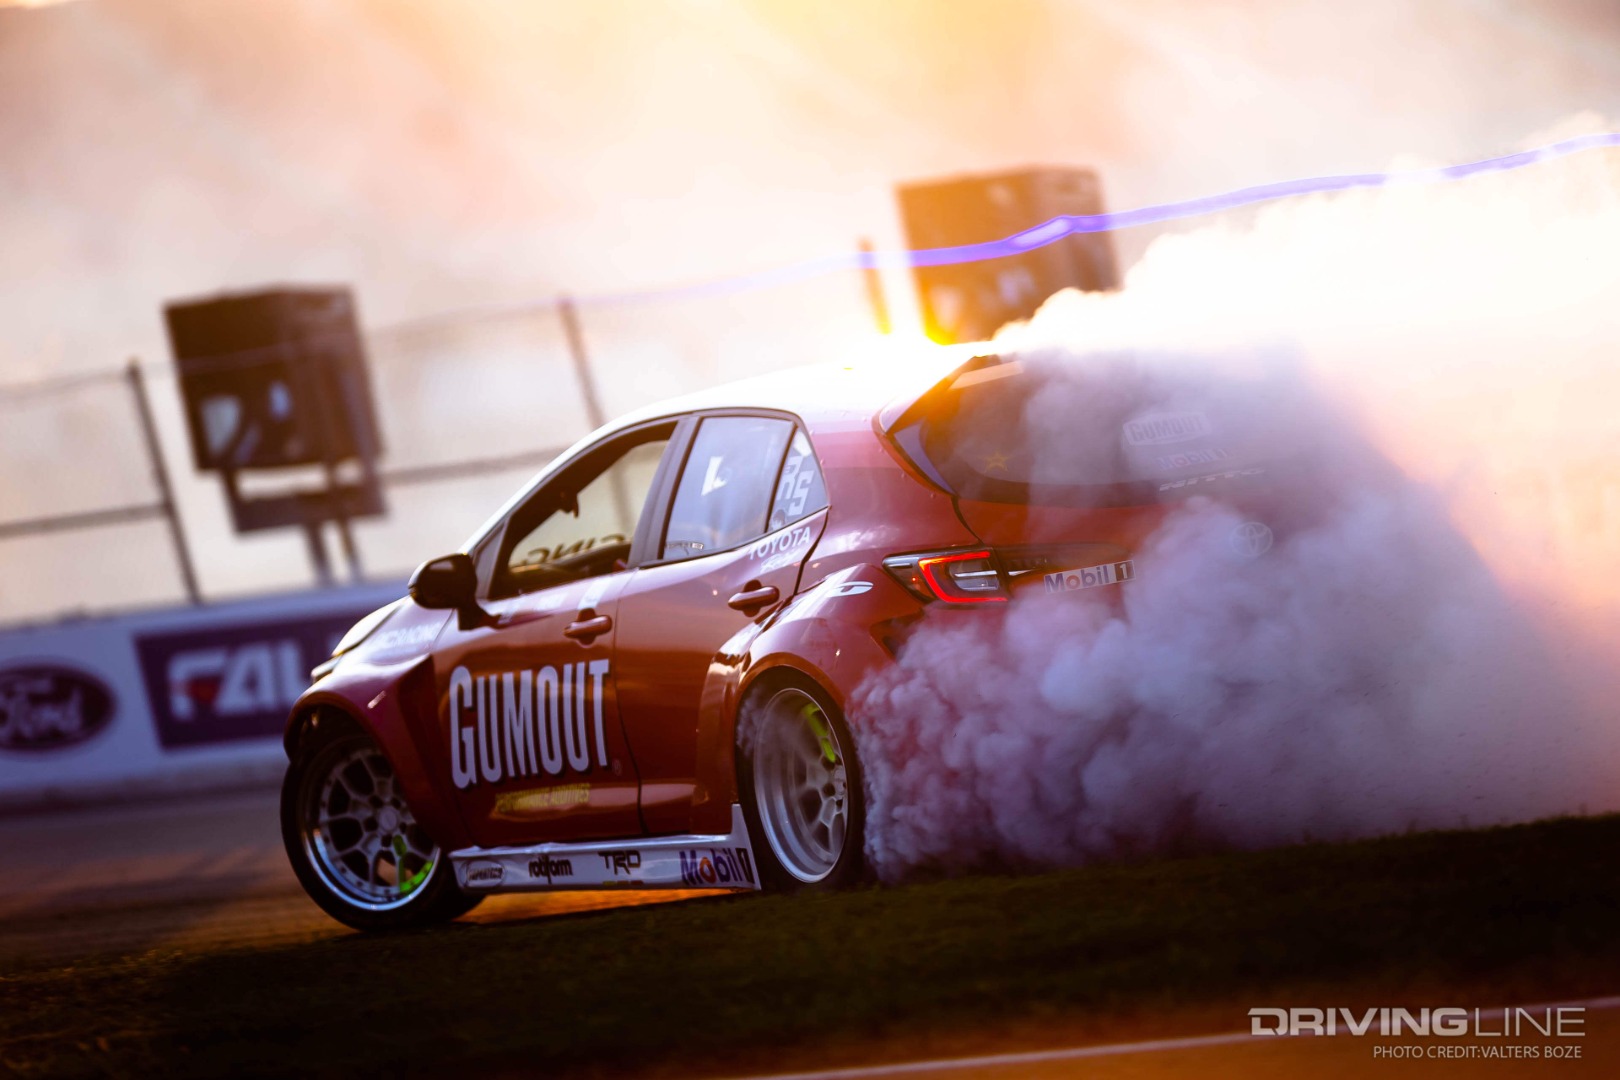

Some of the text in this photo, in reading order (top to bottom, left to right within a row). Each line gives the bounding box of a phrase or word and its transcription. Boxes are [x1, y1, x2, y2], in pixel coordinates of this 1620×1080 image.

[1128, 414, 1203, 442] GUMOUT
[747, 526, 811, 561] TOYOTA
[1044, 565, 1109, 593] Mobil
[449, 658, 610, 789] GUMOUT
[597, 850, 642, 876] TRD
[679, 847, 743, 886] Mobil
